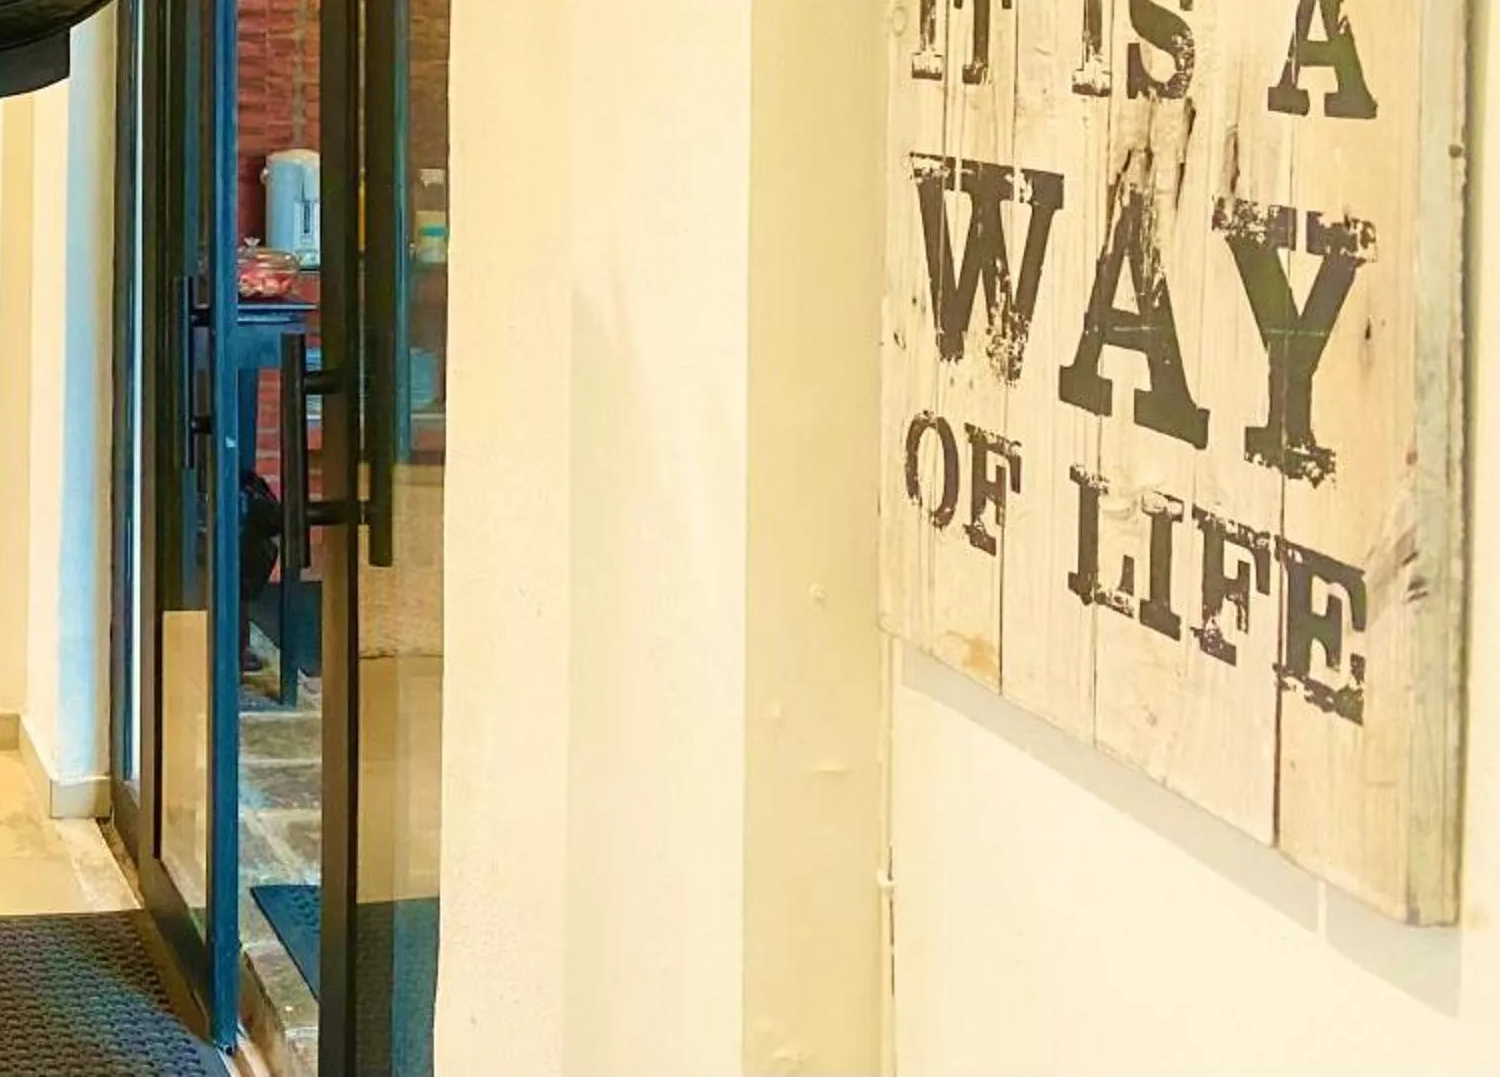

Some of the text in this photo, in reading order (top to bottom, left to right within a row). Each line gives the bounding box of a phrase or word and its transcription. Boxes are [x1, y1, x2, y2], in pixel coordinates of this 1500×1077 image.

[908, 151, 1379, 490] WAY
[904, 410, 1367, 726] OF LIFE
